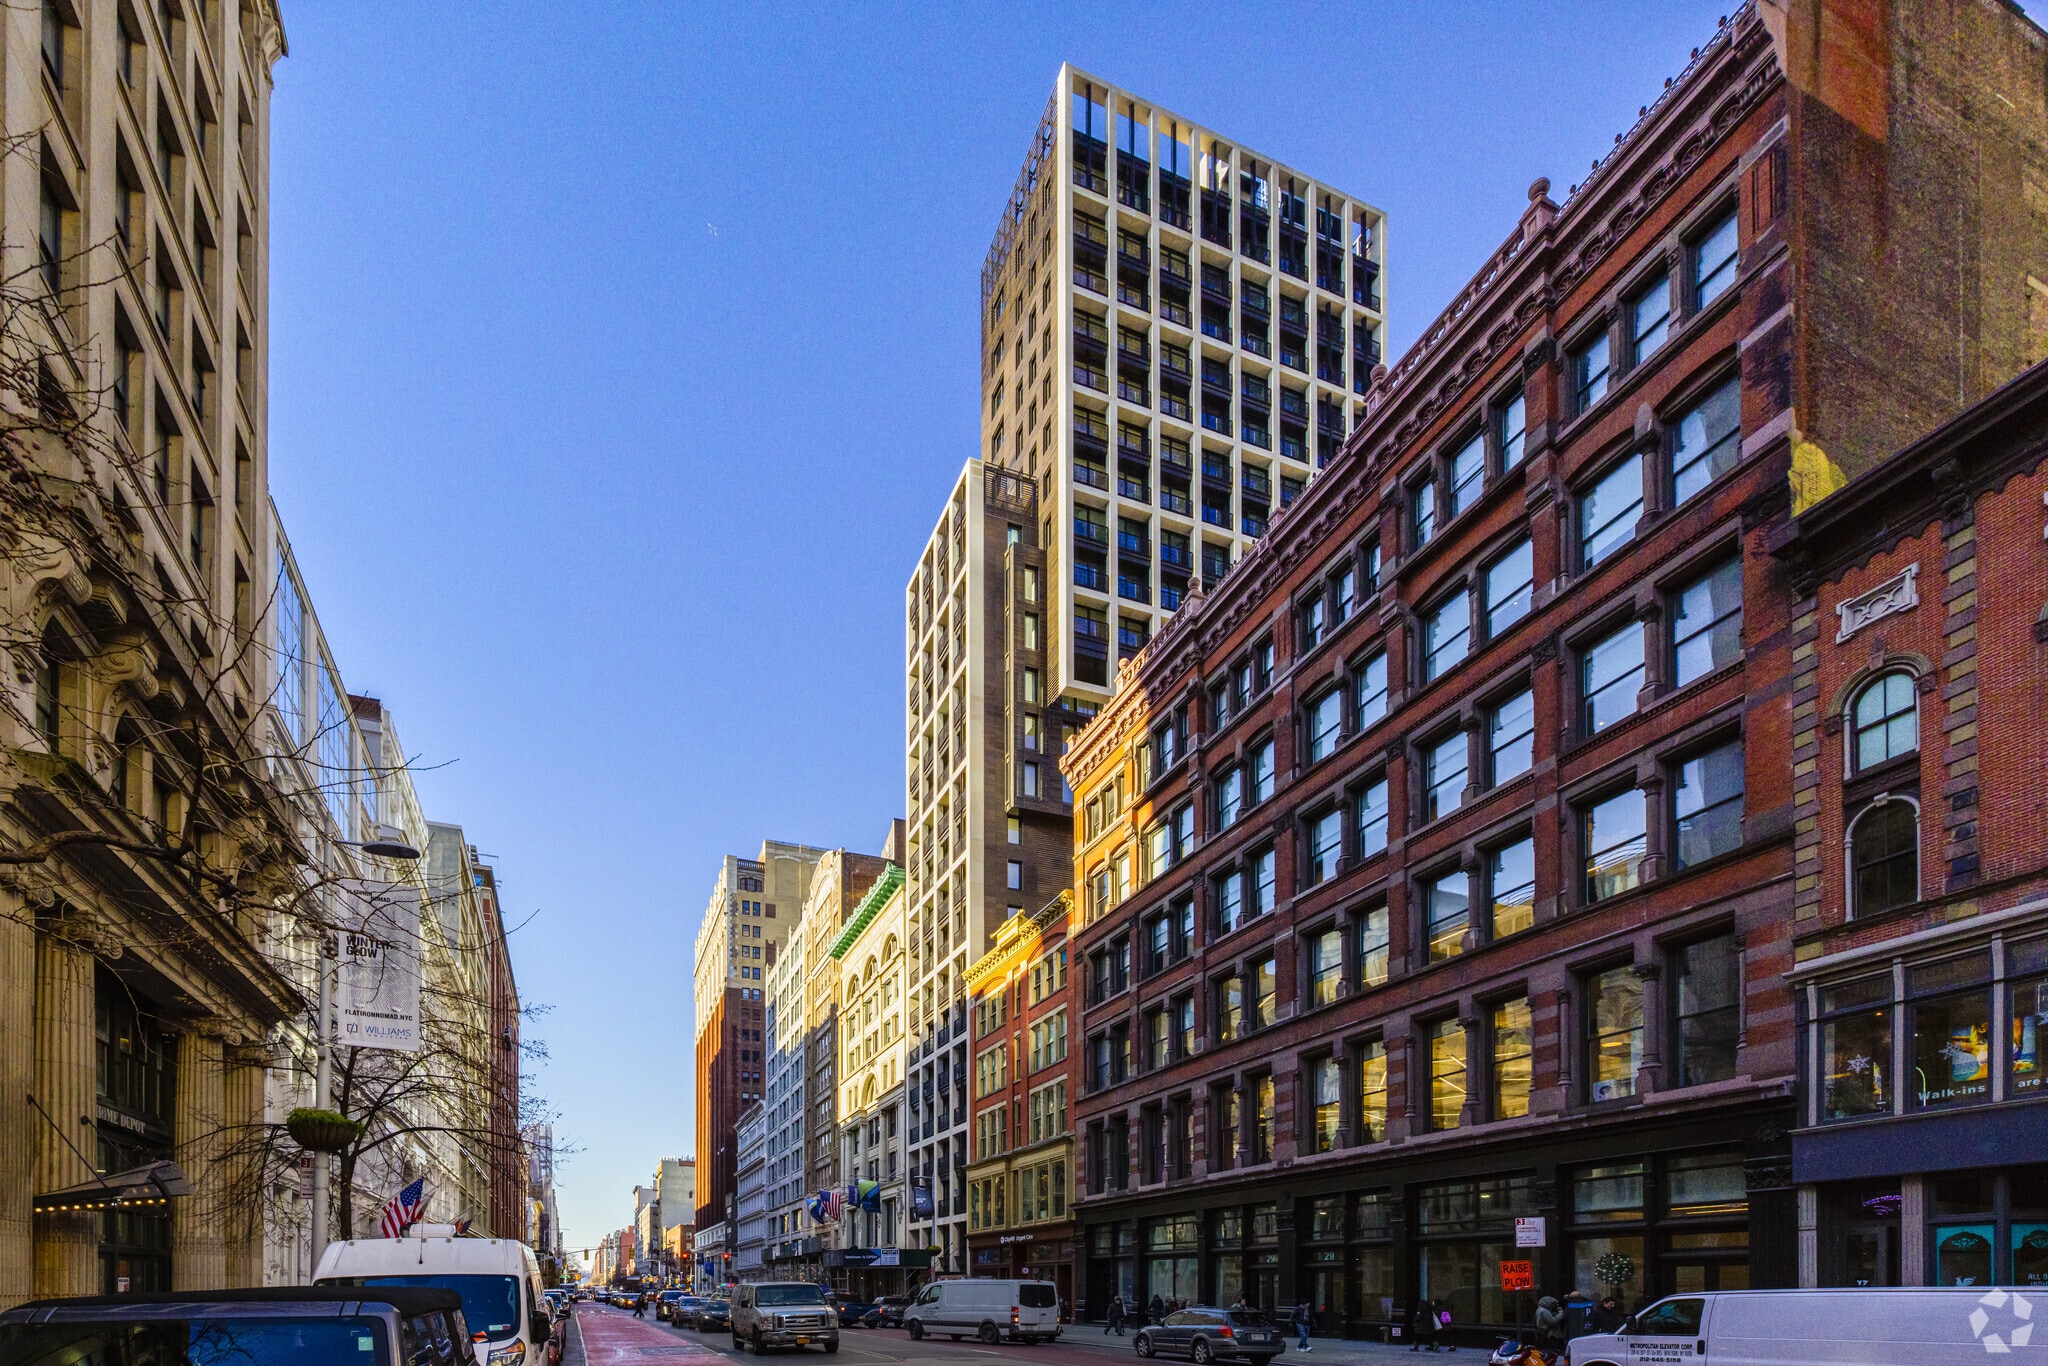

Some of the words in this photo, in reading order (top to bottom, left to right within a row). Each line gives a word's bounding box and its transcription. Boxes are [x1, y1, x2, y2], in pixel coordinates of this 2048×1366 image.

[345, 1008, 413, 1021] FLATIRONNOMAD.NYC
[365, 1025, 412, 1038] WILLIAMS
[2018, 1078, 2041, 1088] are
[1918, 1085, 1986, 1101] Walk-ins
[120, 1113, 146, 1134] DEPOT
[1324, 1252, 1335, 1260] 29
[1503, 1263, 1528, 1273] RAISE
[1504, 1277, 1530, 1288] PLOW
[1586, 1308, 1591, 1316] P
